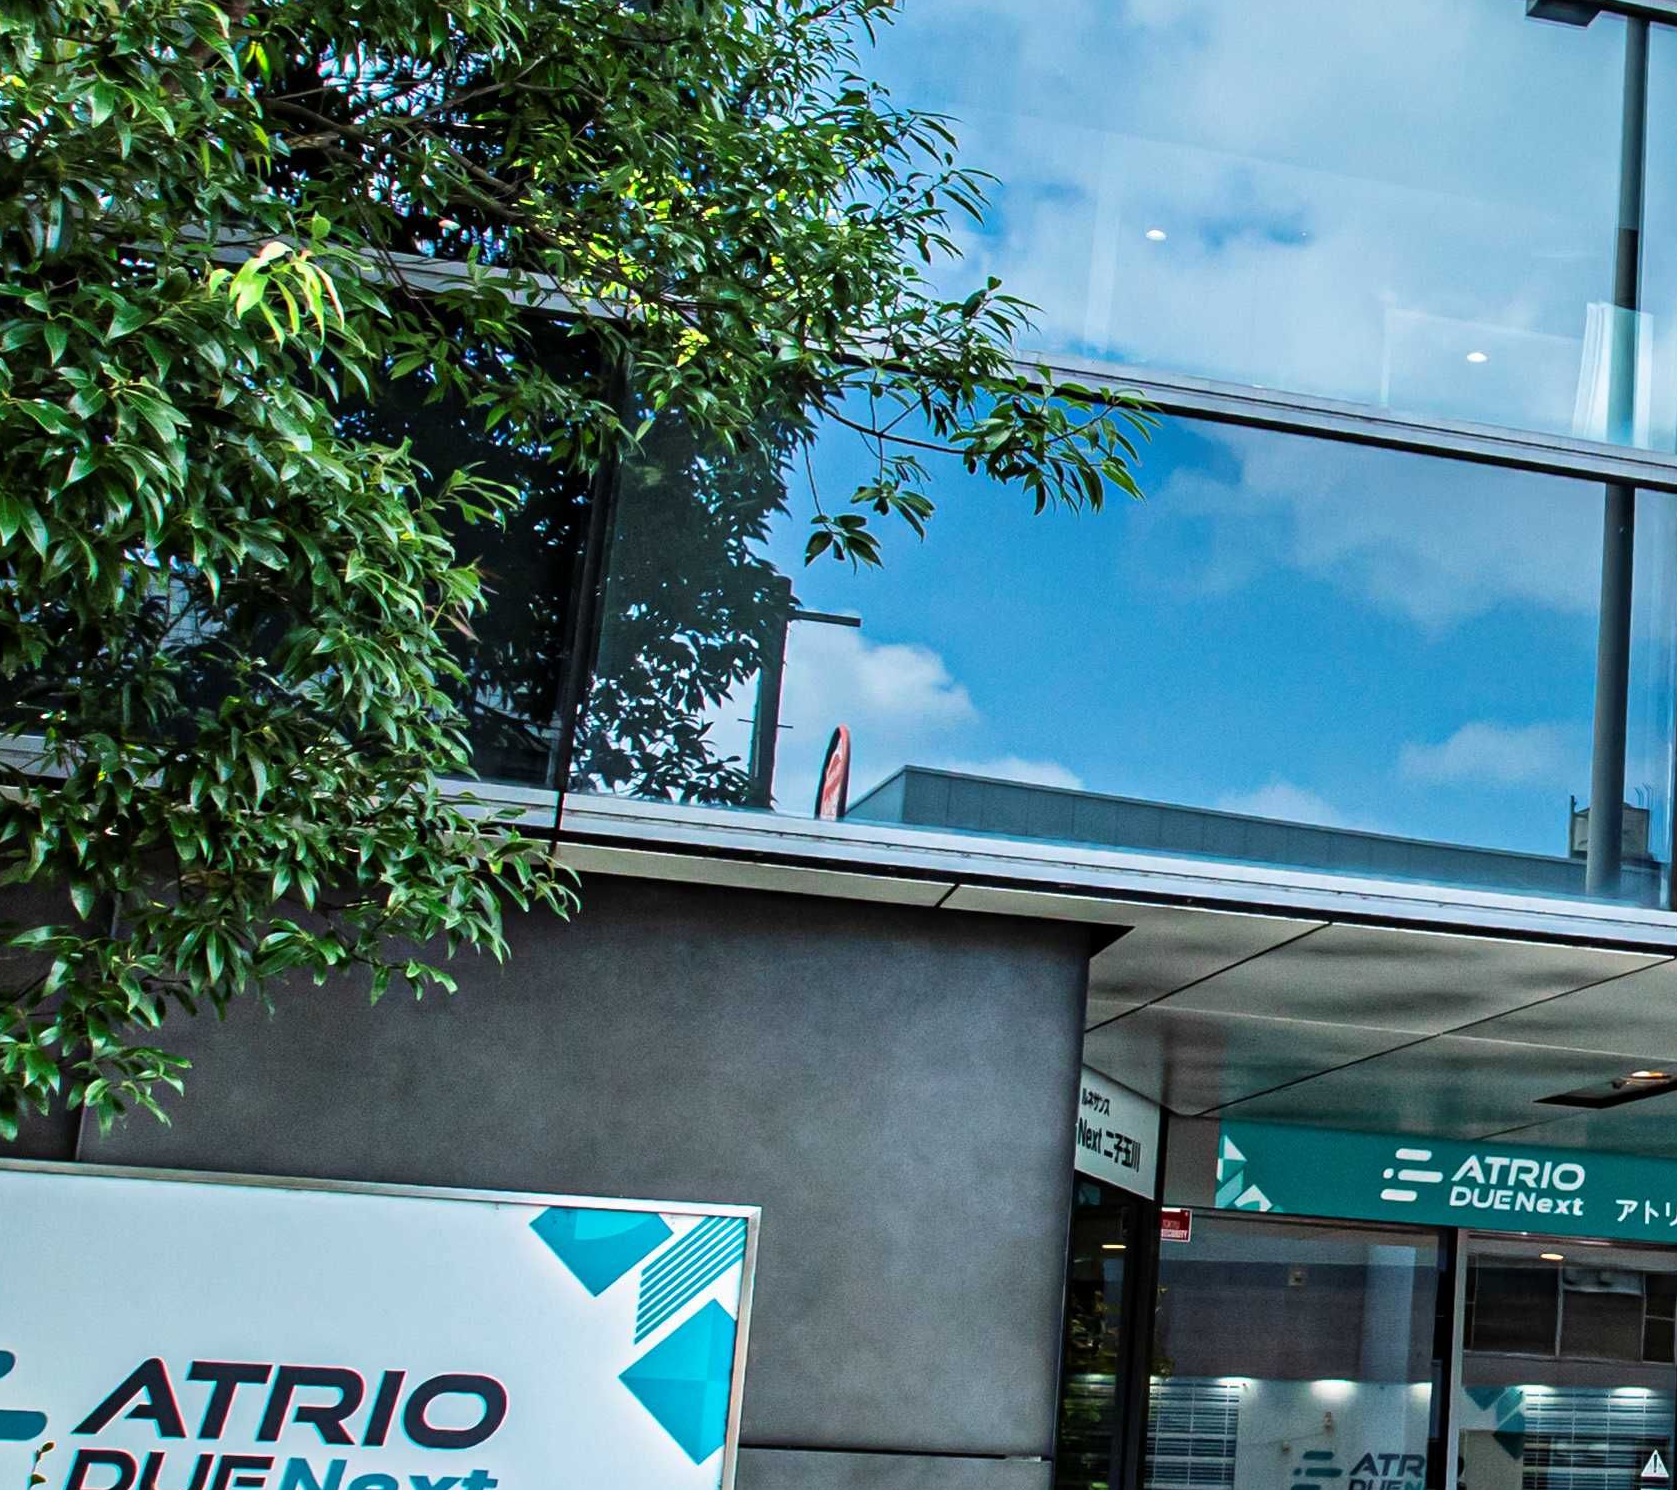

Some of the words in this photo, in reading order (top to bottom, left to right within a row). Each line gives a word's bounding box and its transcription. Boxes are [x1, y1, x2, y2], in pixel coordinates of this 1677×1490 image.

[1103, 1131, 1141, 1173] 二子玉川
[1451, 1154, 1586, 1191] ATRIO
[70, 1356, 509, 1450] ATRIO
